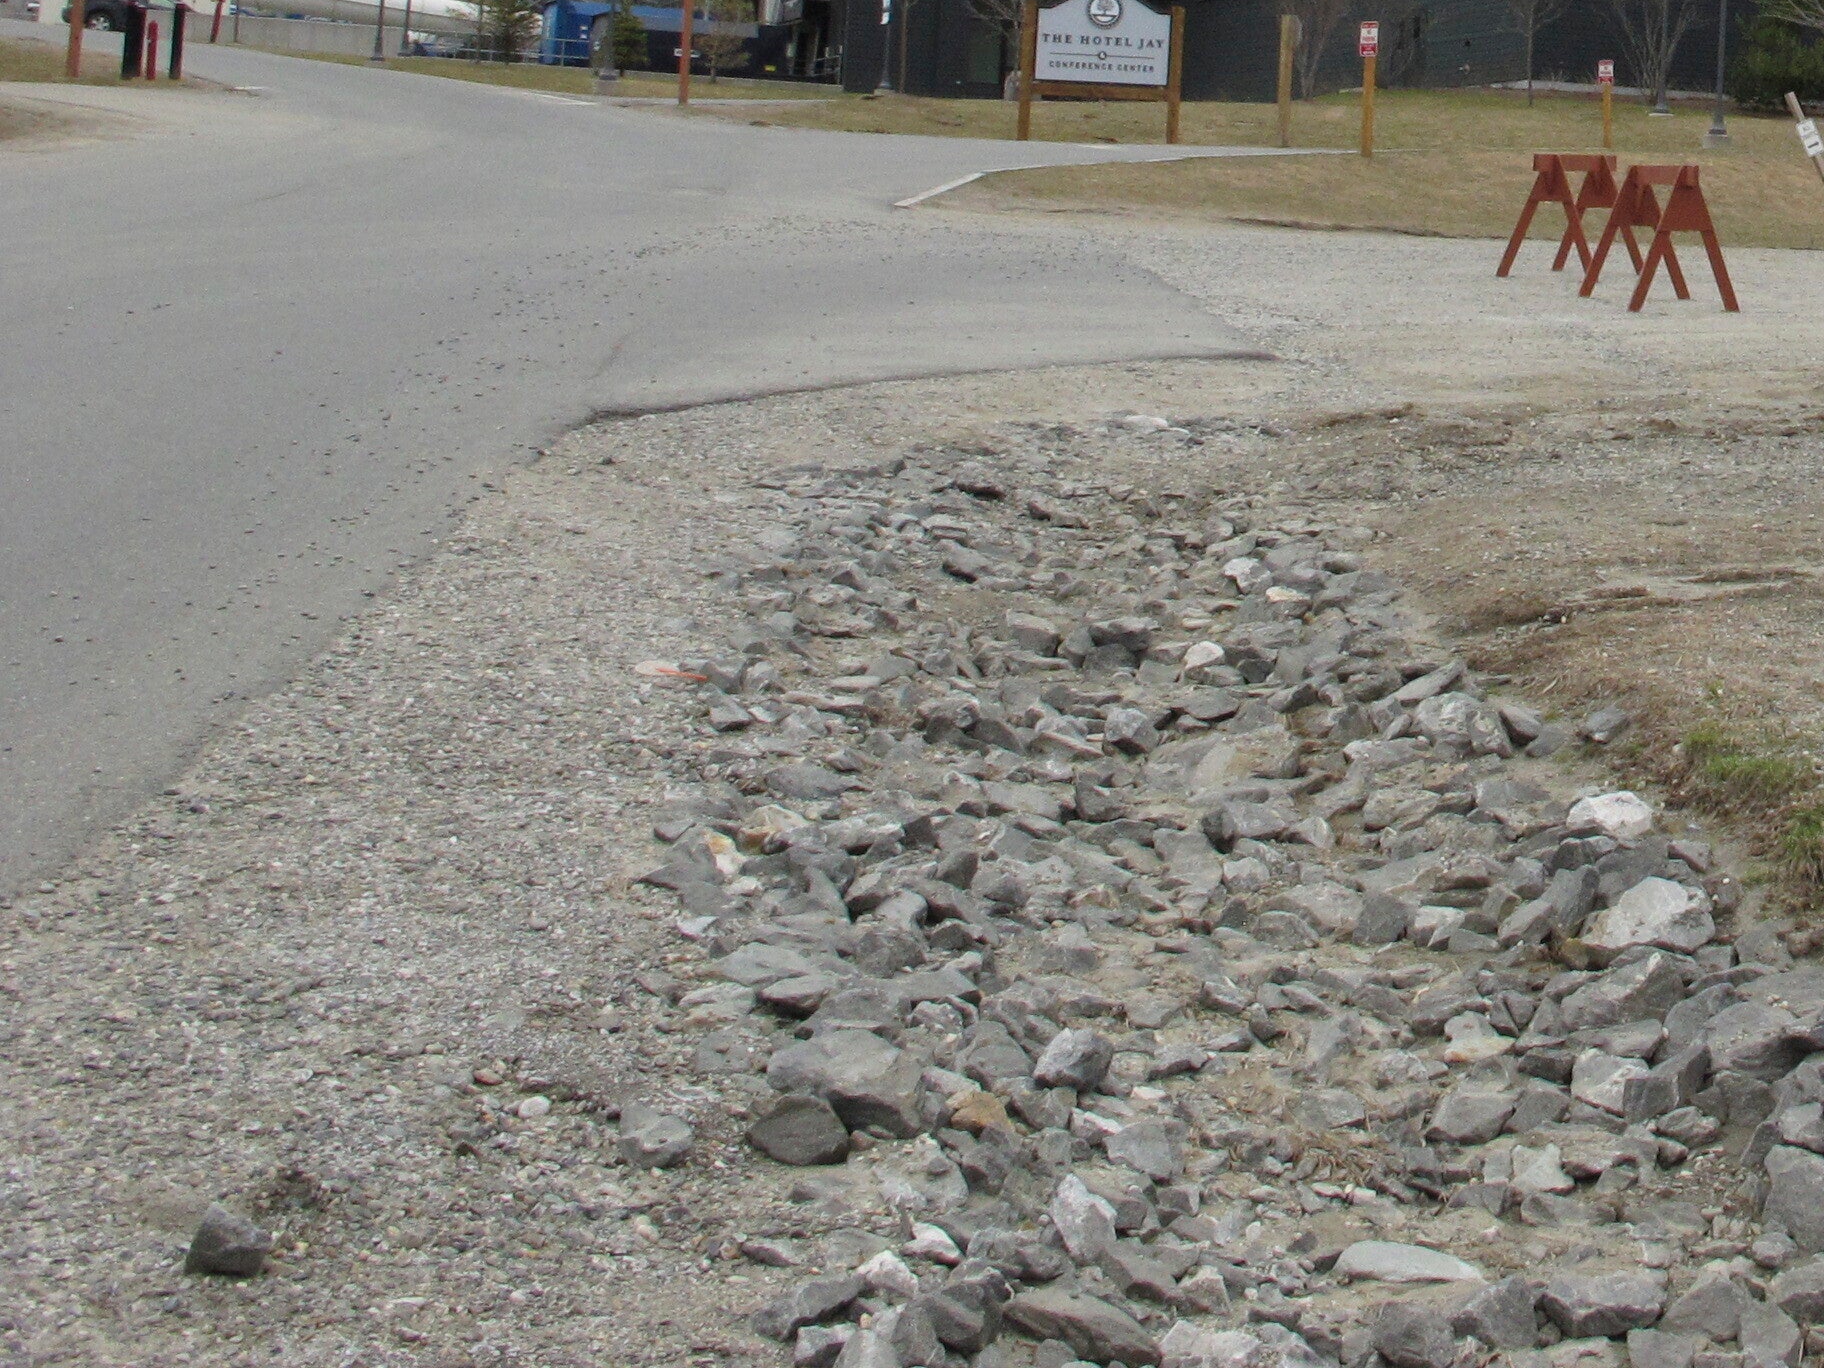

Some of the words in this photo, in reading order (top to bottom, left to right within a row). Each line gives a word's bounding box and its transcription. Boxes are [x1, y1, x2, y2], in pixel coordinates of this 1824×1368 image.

[1042, 33, 1072, 44] THE
[1080, 35, 1132, 47] HOTEL
[1137, 38, 1164, 50] JAY
[1049, 60, 1113, 71] CONFERENCE
[1117, 64, 1154, 73] CENTER
